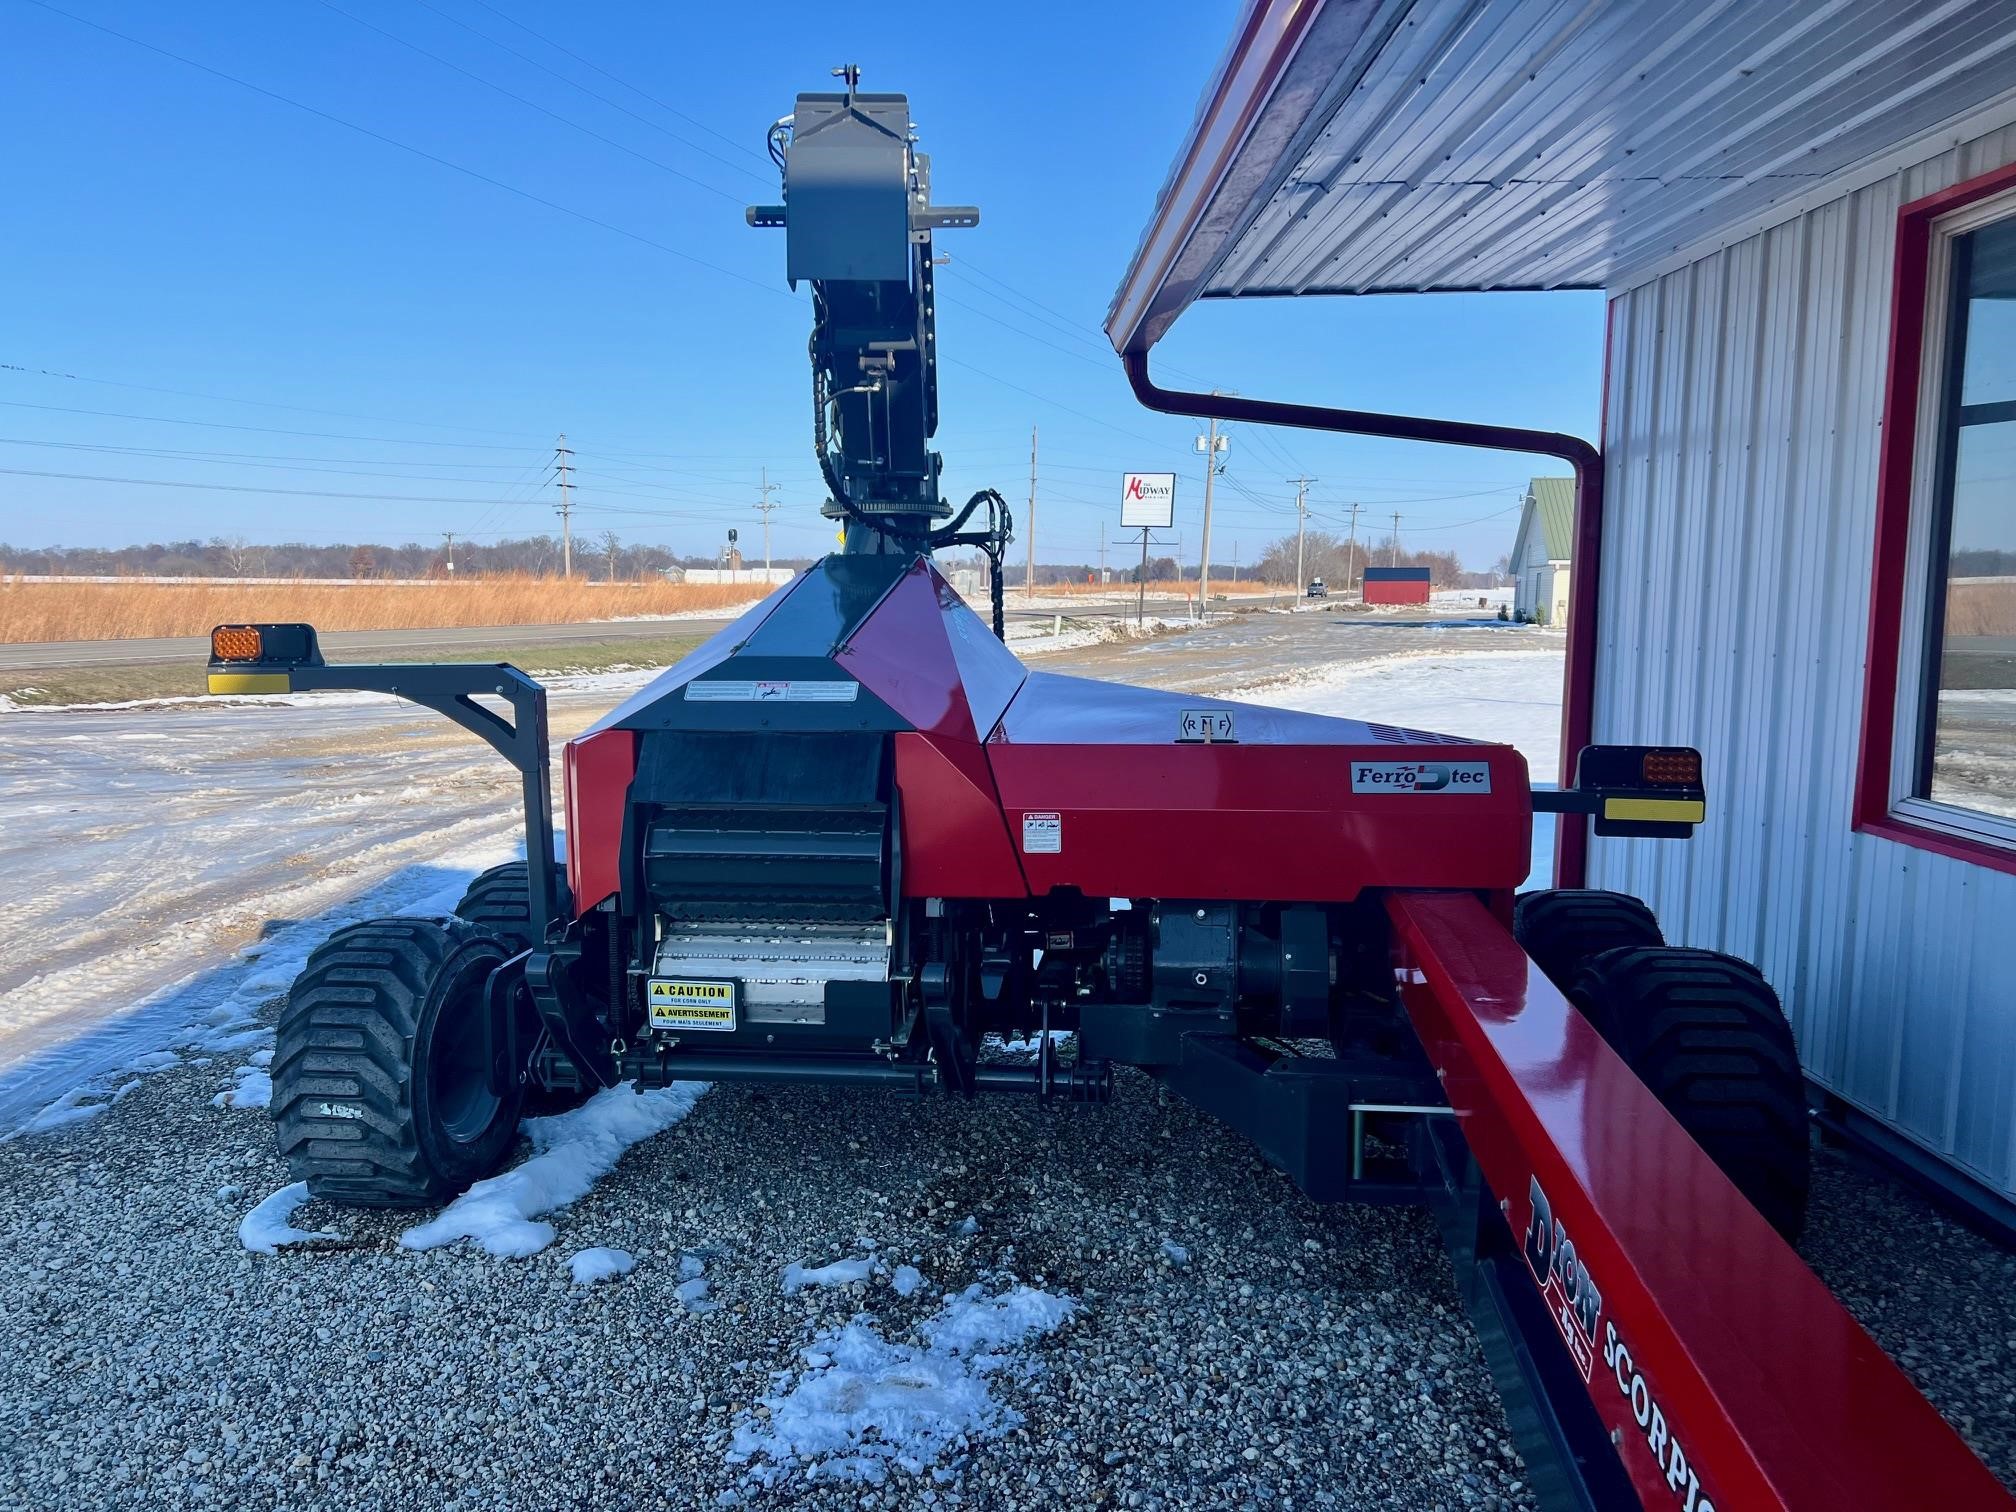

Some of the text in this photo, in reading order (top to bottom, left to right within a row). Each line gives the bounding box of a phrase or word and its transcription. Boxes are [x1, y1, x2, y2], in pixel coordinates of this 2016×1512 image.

[1125, 477, 1171, 500] MIDWAY
[1187, 720, 1196, 730] R
[1219, 720, 1227, 730] F
[669, 985, 725, 998] CAUTION
[668, 1009, 730, 1019] AVERTISSEMENT
[1524, 1173, 1602, 1348] DION
[1604, 1321, 1716, 1512] SCORPI
